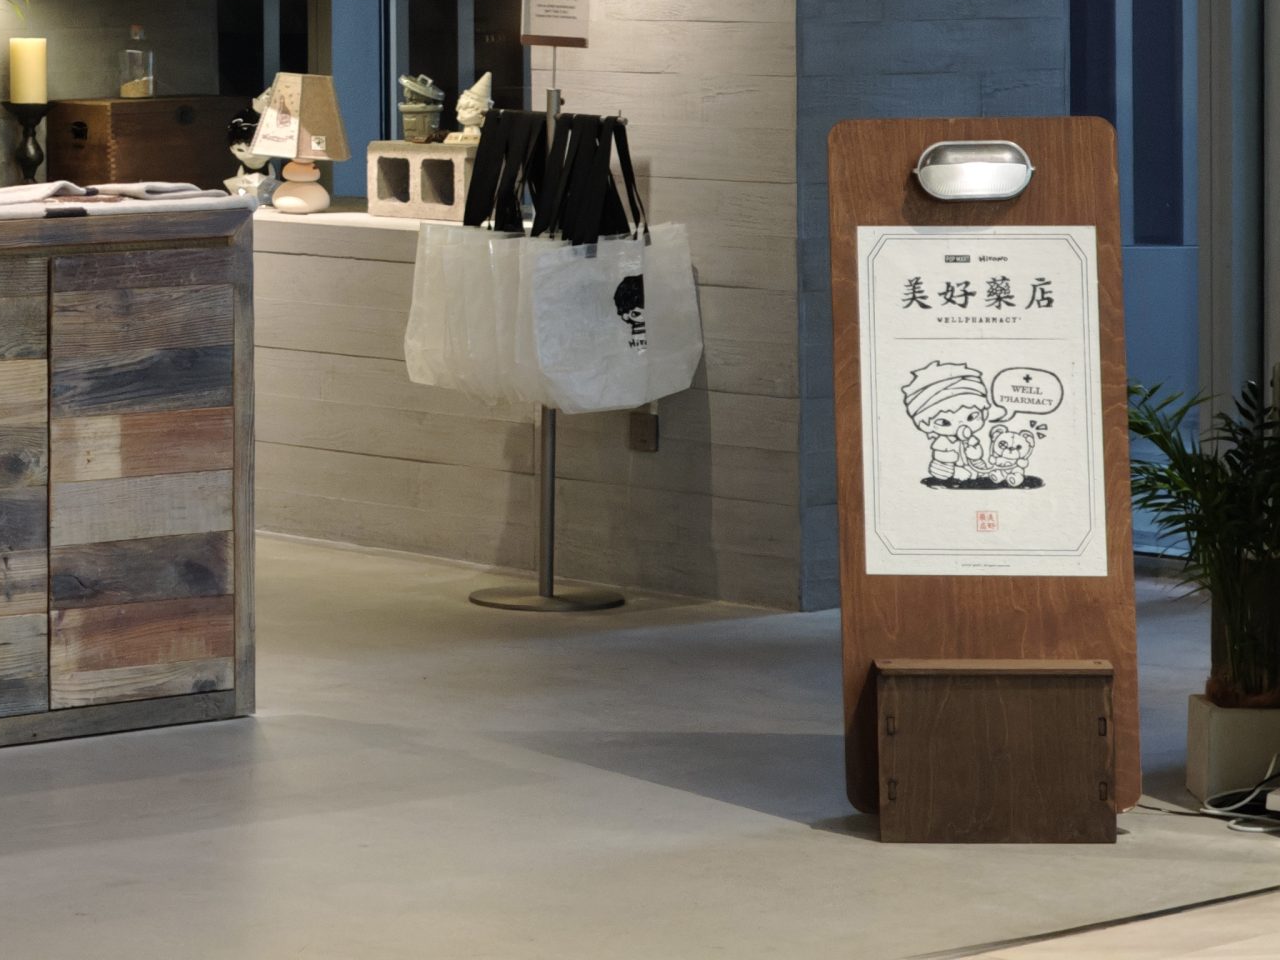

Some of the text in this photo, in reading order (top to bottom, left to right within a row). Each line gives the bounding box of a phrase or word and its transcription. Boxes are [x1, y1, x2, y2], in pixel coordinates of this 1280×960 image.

[901, 275, 1055, 310] 美好藥店
[1011, 385, 1043, 395] WELL
[1000, 395, 1053, 406] PHARMACY
